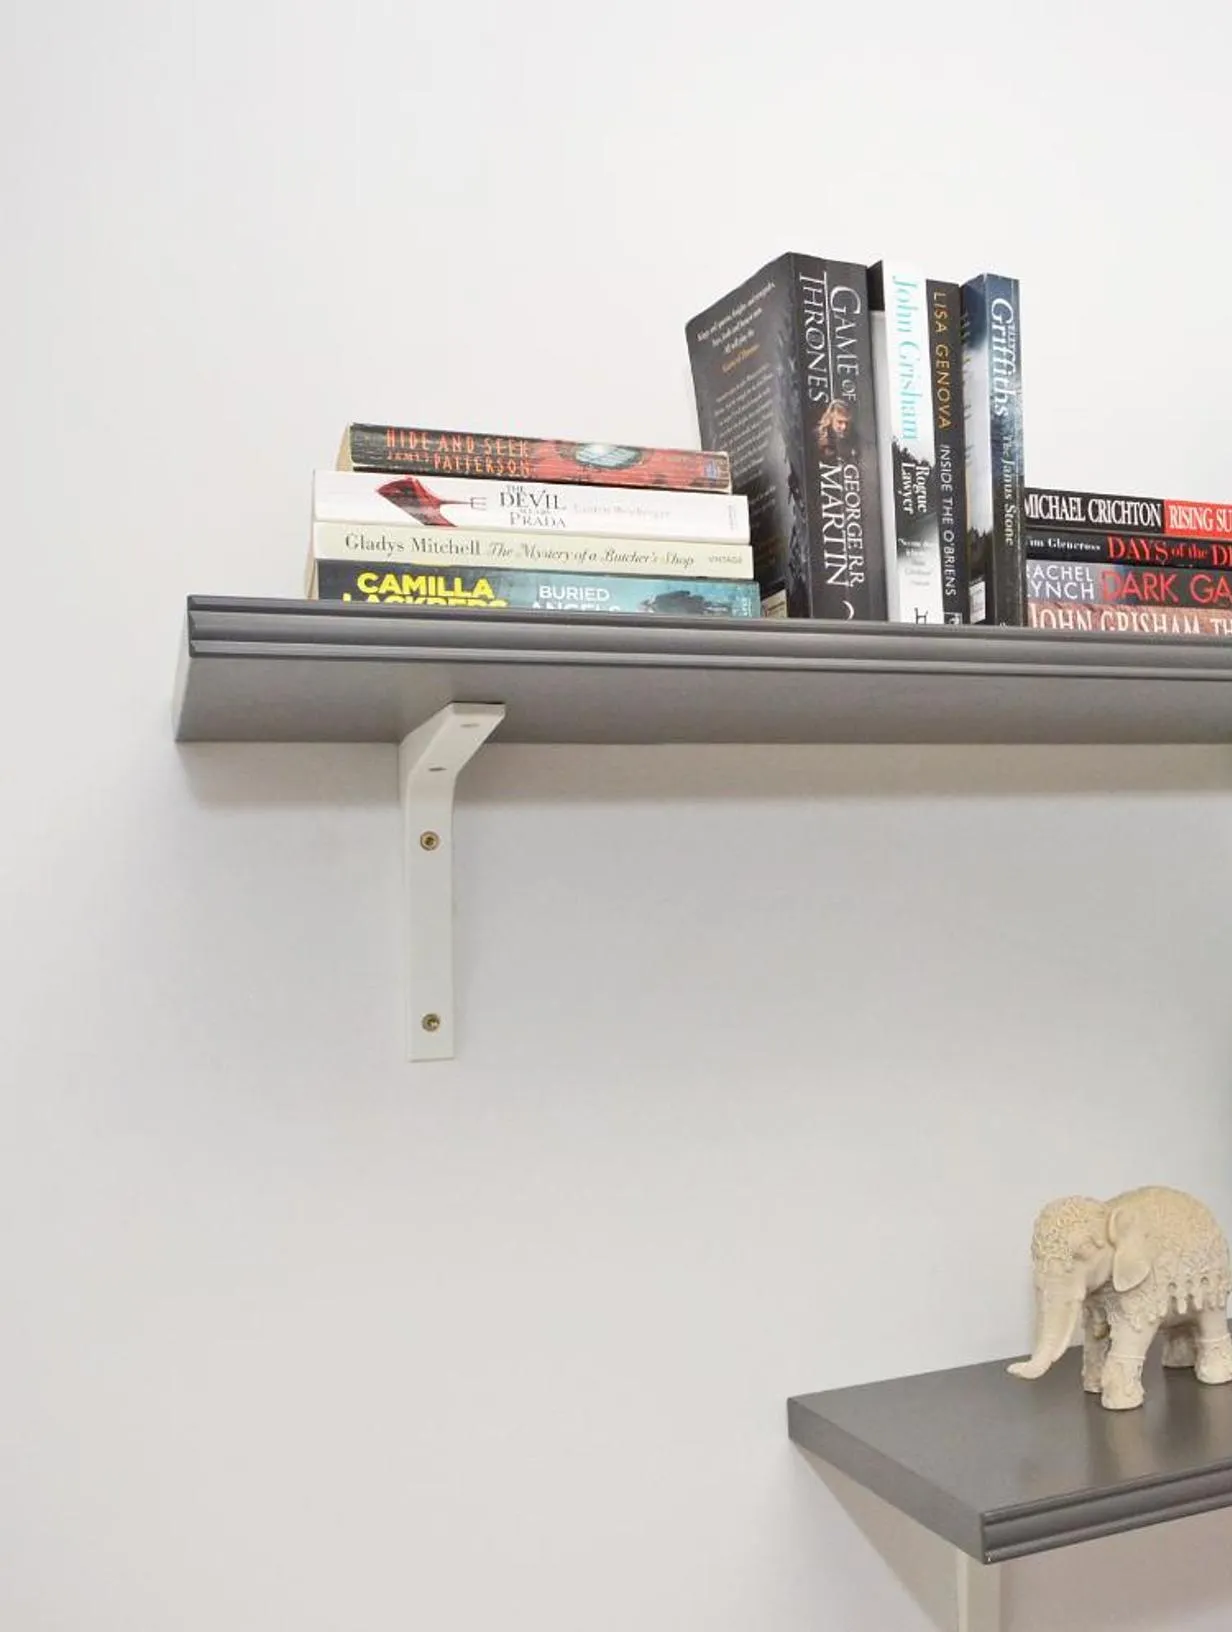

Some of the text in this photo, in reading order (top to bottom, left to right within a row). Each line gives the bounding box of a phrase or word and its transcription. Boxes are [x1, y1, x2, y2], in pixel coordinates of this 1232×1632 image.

[799, 271, 829, 404] THRONES
[830, 286, 860, 401] GAME OF
[892, 275, 923, 440] John Grisham
[933, 290, 952, 430] LISA GENOVA
[991, 298, 1016, 418] Griffiths
[386, 426, 529, 458] HIDE AND SEEK
[433, 452, 532, 477] PATTERSON
[1001, 457, 1016, 500] Janus
[500, 490, 567, 510] DEVIL
[897, 462, 916, 515] Lawyer
[914, 464, 929, 513] Rogue
[510, 511, 566, 528] PRADA
[844, 464, 863, 549] GEORGE
[939, 444, 957, 596] INSIDE THE O'BRIENS
[1024, 494, 1162, 528] MICHAEL CRICHTON
[1168, 504, 1213, 531] RISING
[819, 462, 850, 588] MARTIN
[1003, 503, 1018, 546] Stone
[345, 533, 480, 557] Gladys Mitchell
[1107, 536, 1168, 563] DAYS
[1171, 543, 1185, 559] of
[1188, 543, 1208, 559] the
[356, 572, 495, 600] CAMILLA
[539, 585, 610, 602] BURIED
[1027, 580, 1094, 600] YNCH
[1102, 570, 1179, 603] DARK
[1030, 603, 1092, 631] JOHN
